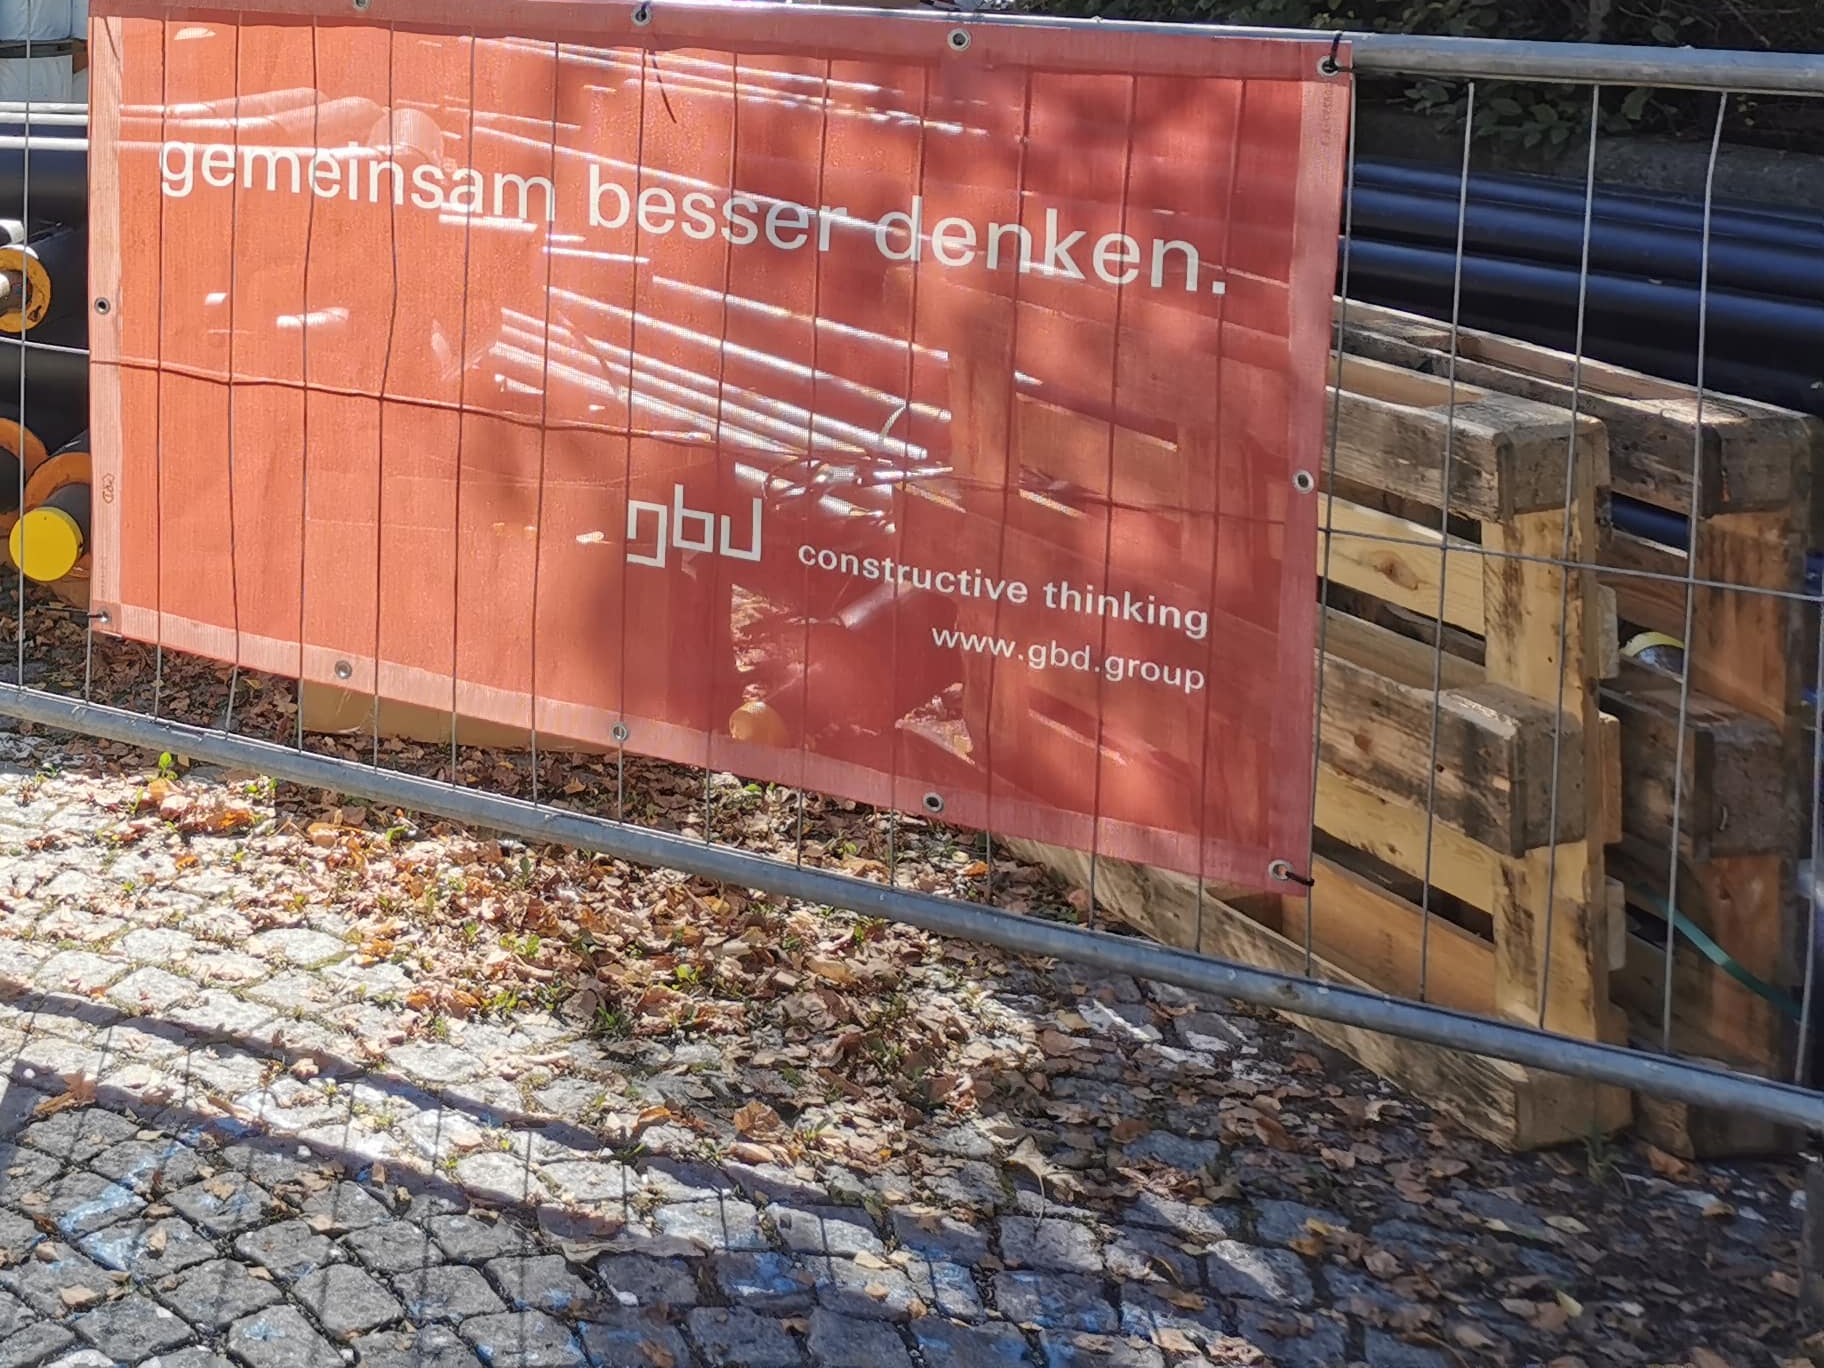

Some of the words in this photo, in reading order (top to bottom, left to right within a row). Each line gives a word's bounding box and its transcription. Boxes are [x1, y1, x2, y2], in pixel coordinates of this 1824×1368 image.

[159, 140, 556, 222] gemeinsam
[588, 163, 848, 252] besser
[875, 194, 1226, 295] denken.
[797, 543, 1029, 604] constructive
[1042, 580, 1209, 641] thinking
[930, 625, 1207, 694] www.gbd.group
